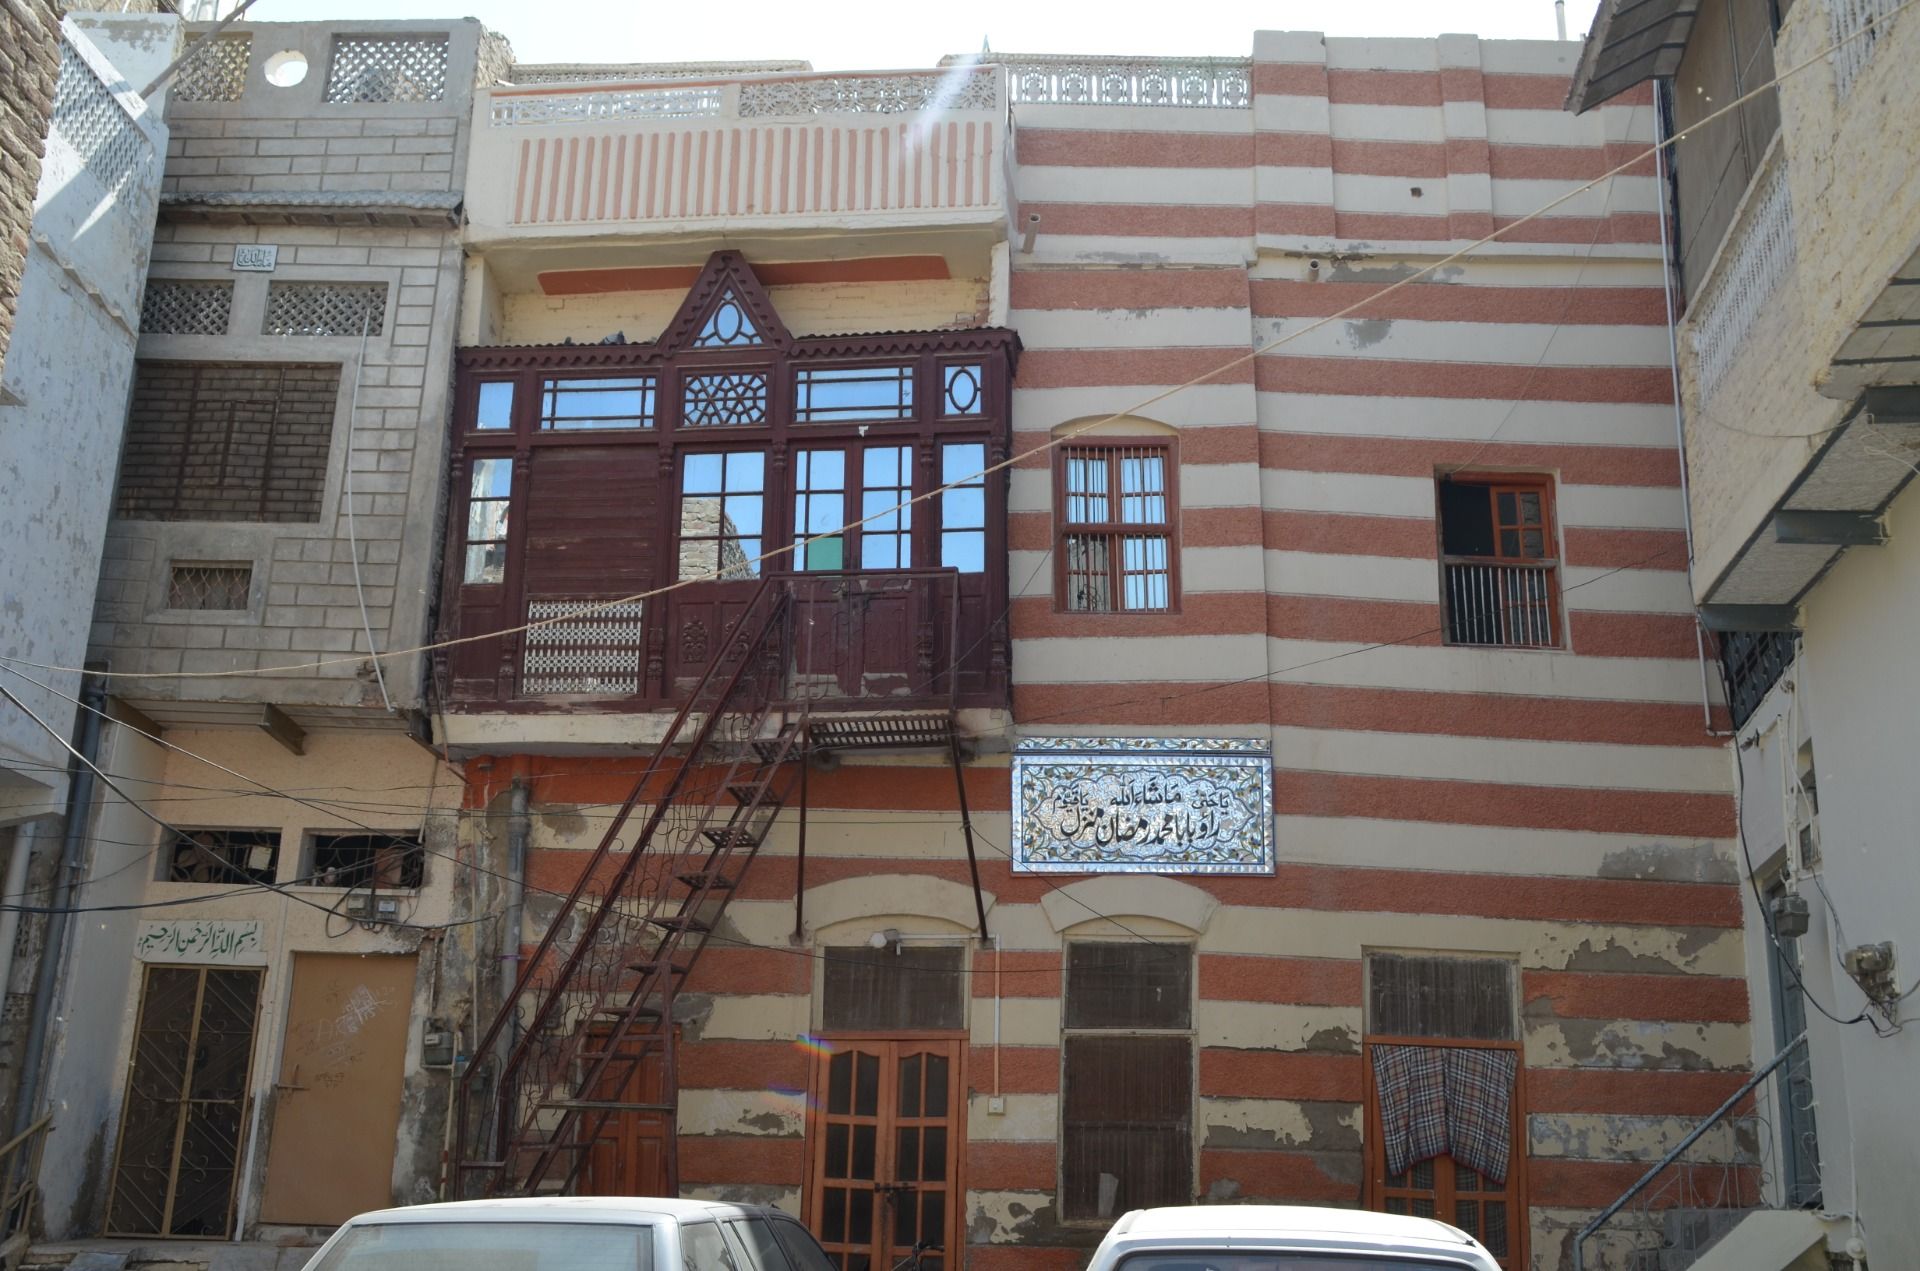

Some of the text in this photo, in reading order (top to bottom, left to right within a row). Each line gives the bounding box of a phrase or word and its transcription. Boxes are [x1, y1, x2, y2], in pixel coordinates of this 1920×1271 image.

[1061, 806, 1104, 840] منزل
[1096, 808, 1151, 847] رمضان
[1143, 814, 1174, 846] محمد
[1175, 811, 1196, 847] بابا
